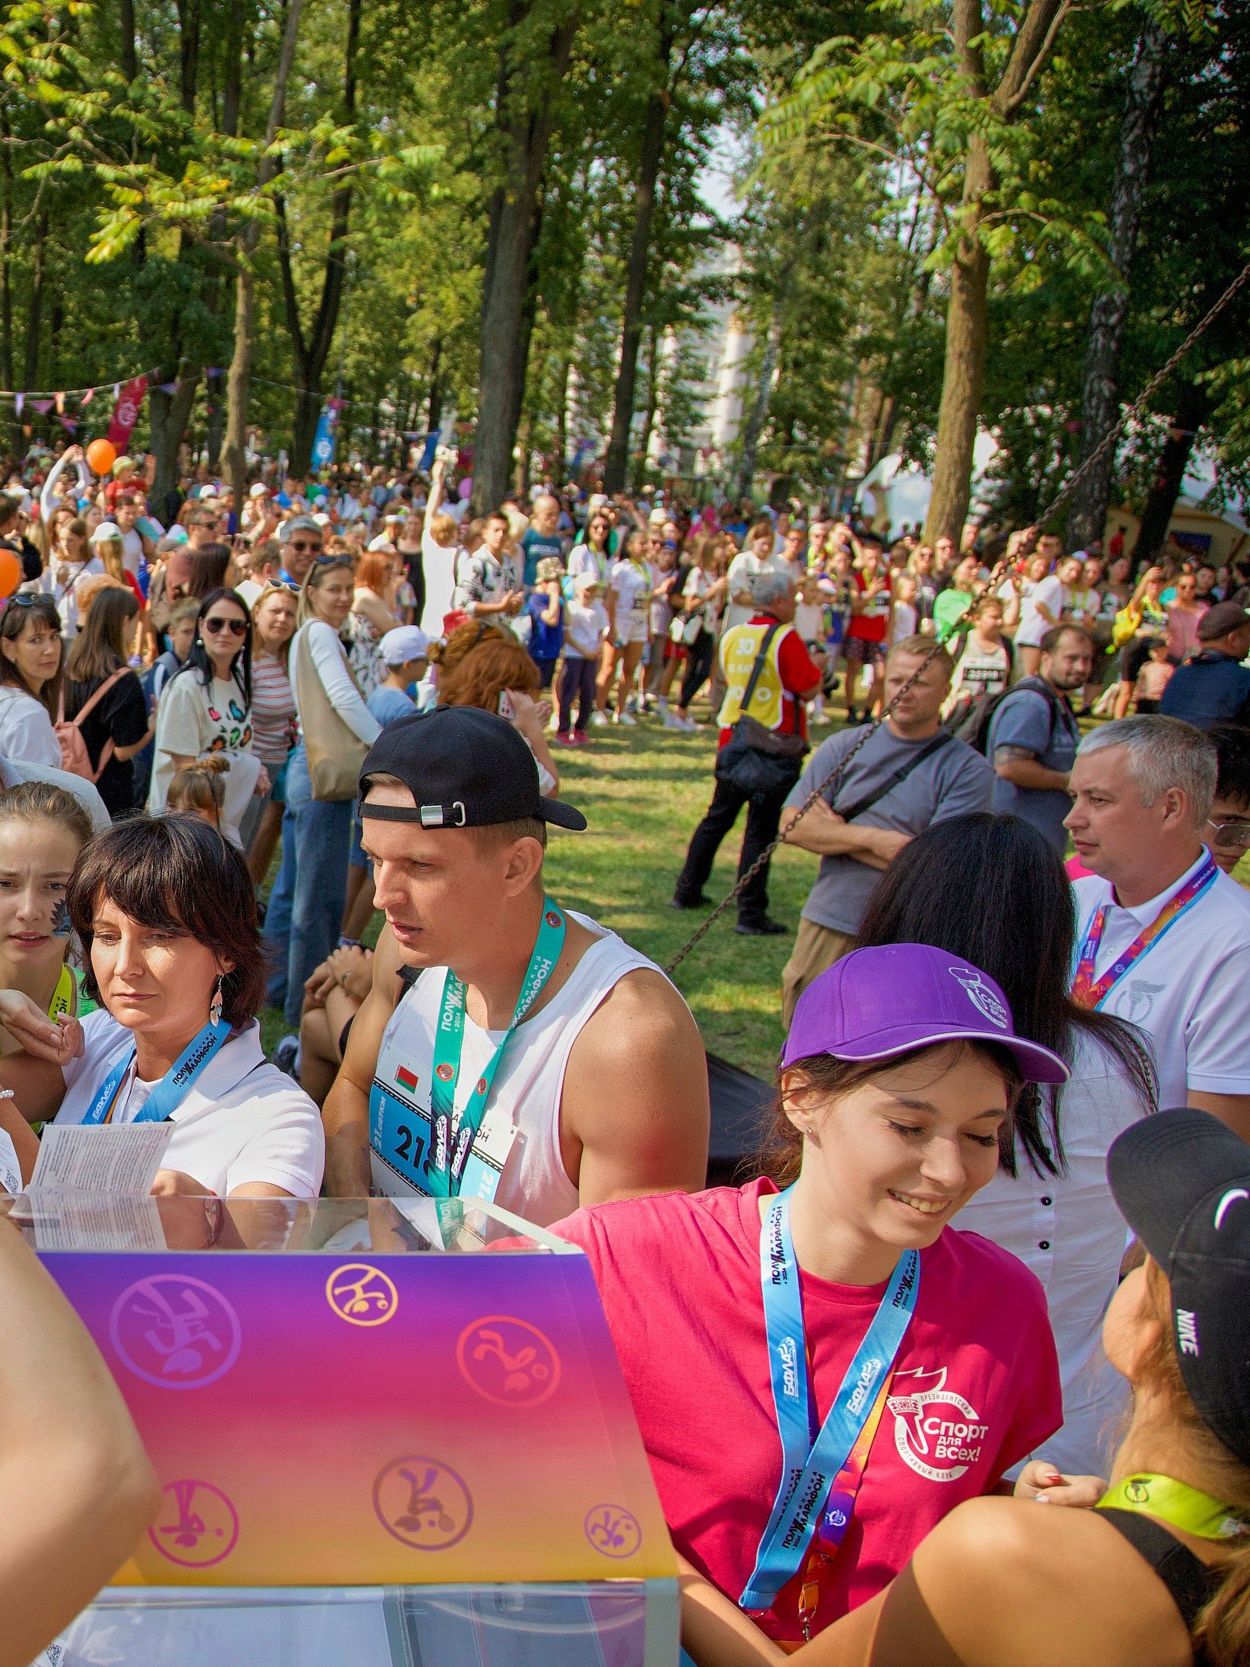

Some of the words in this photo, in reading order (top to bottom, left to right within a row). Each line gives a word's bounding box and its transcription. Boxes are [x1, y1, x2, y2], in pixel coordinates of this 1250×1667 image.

[1176, 1308, 1198, 1358] NIKE
[924, 1418, 989, 1442] Спорт
[937, 1436, 962, 1446] для
